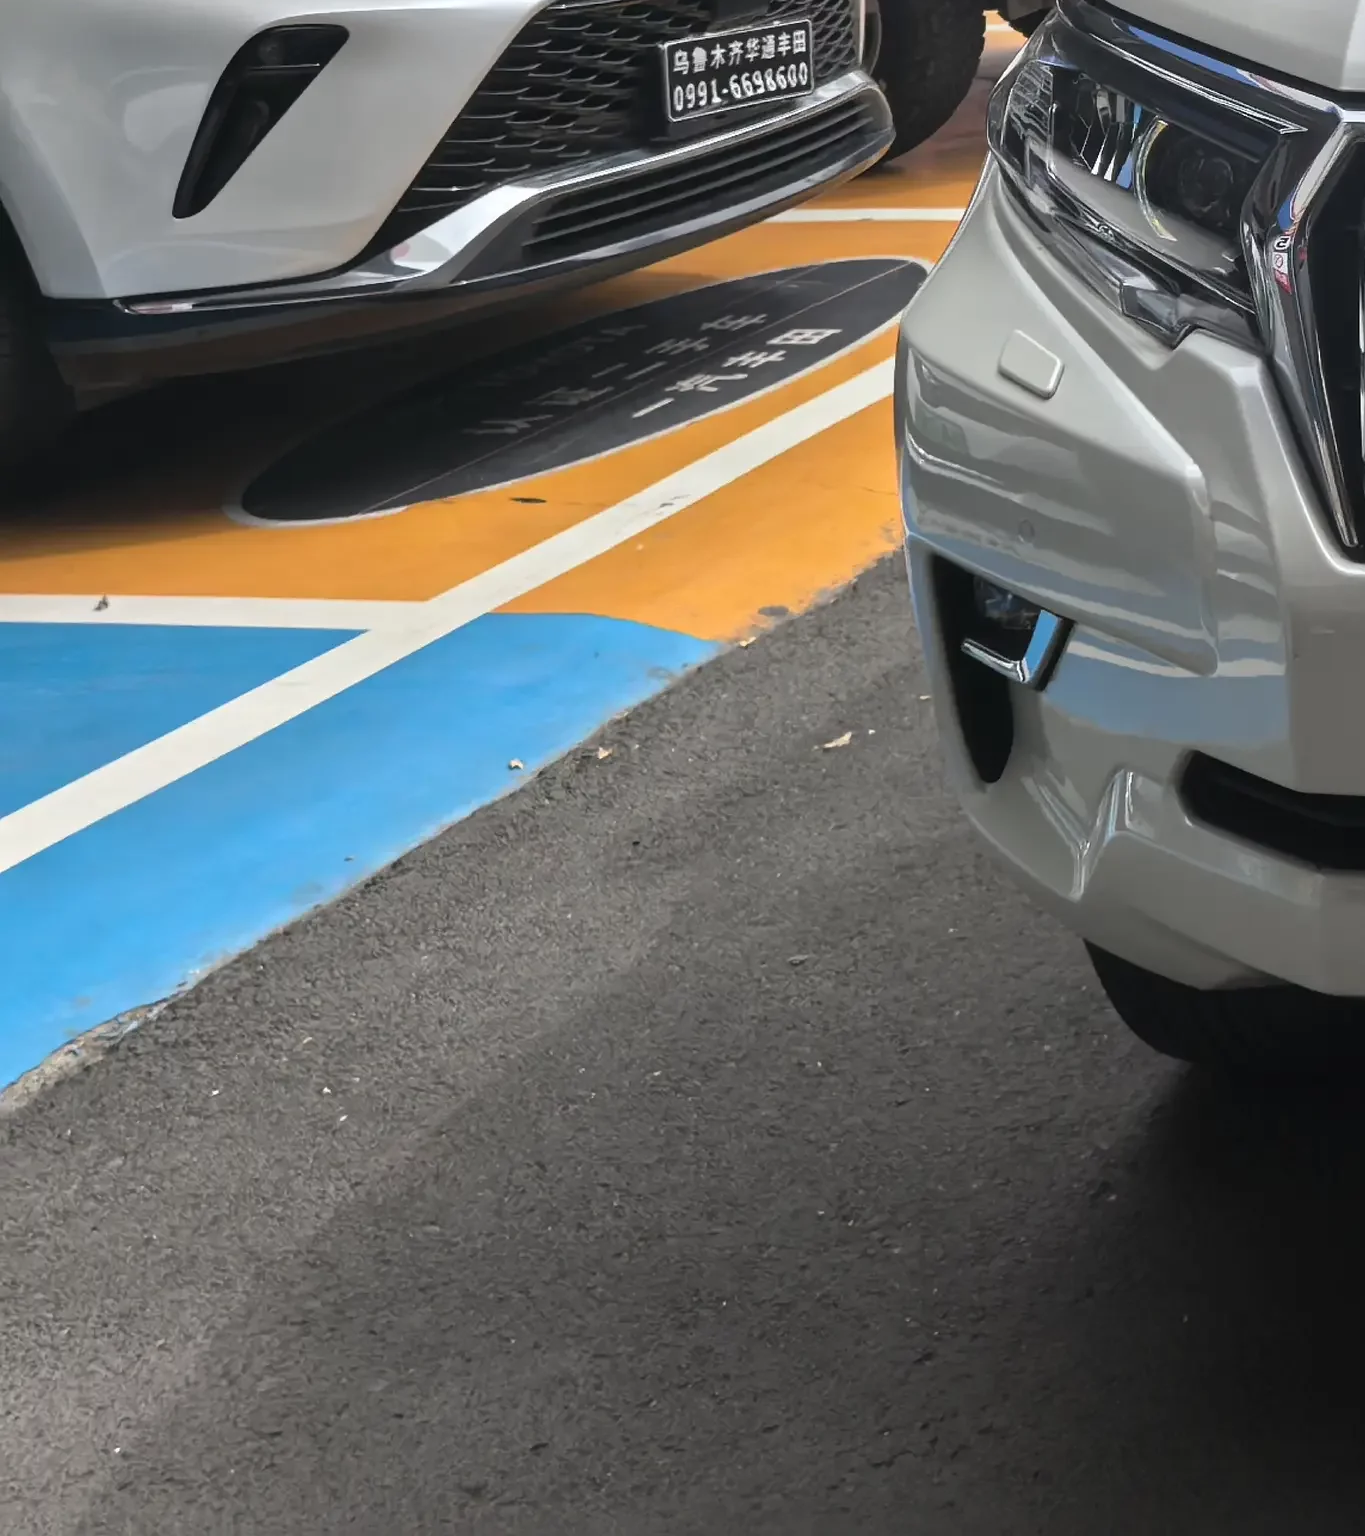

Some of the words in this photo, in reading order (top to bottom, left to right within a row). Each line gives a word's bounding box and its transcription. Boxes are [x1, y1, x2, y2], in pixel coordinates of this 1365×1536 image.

[672, 29, 807, 75] 乌鲁木齐华通丰田
[673, 61, 808, 112] 0991-6698600
